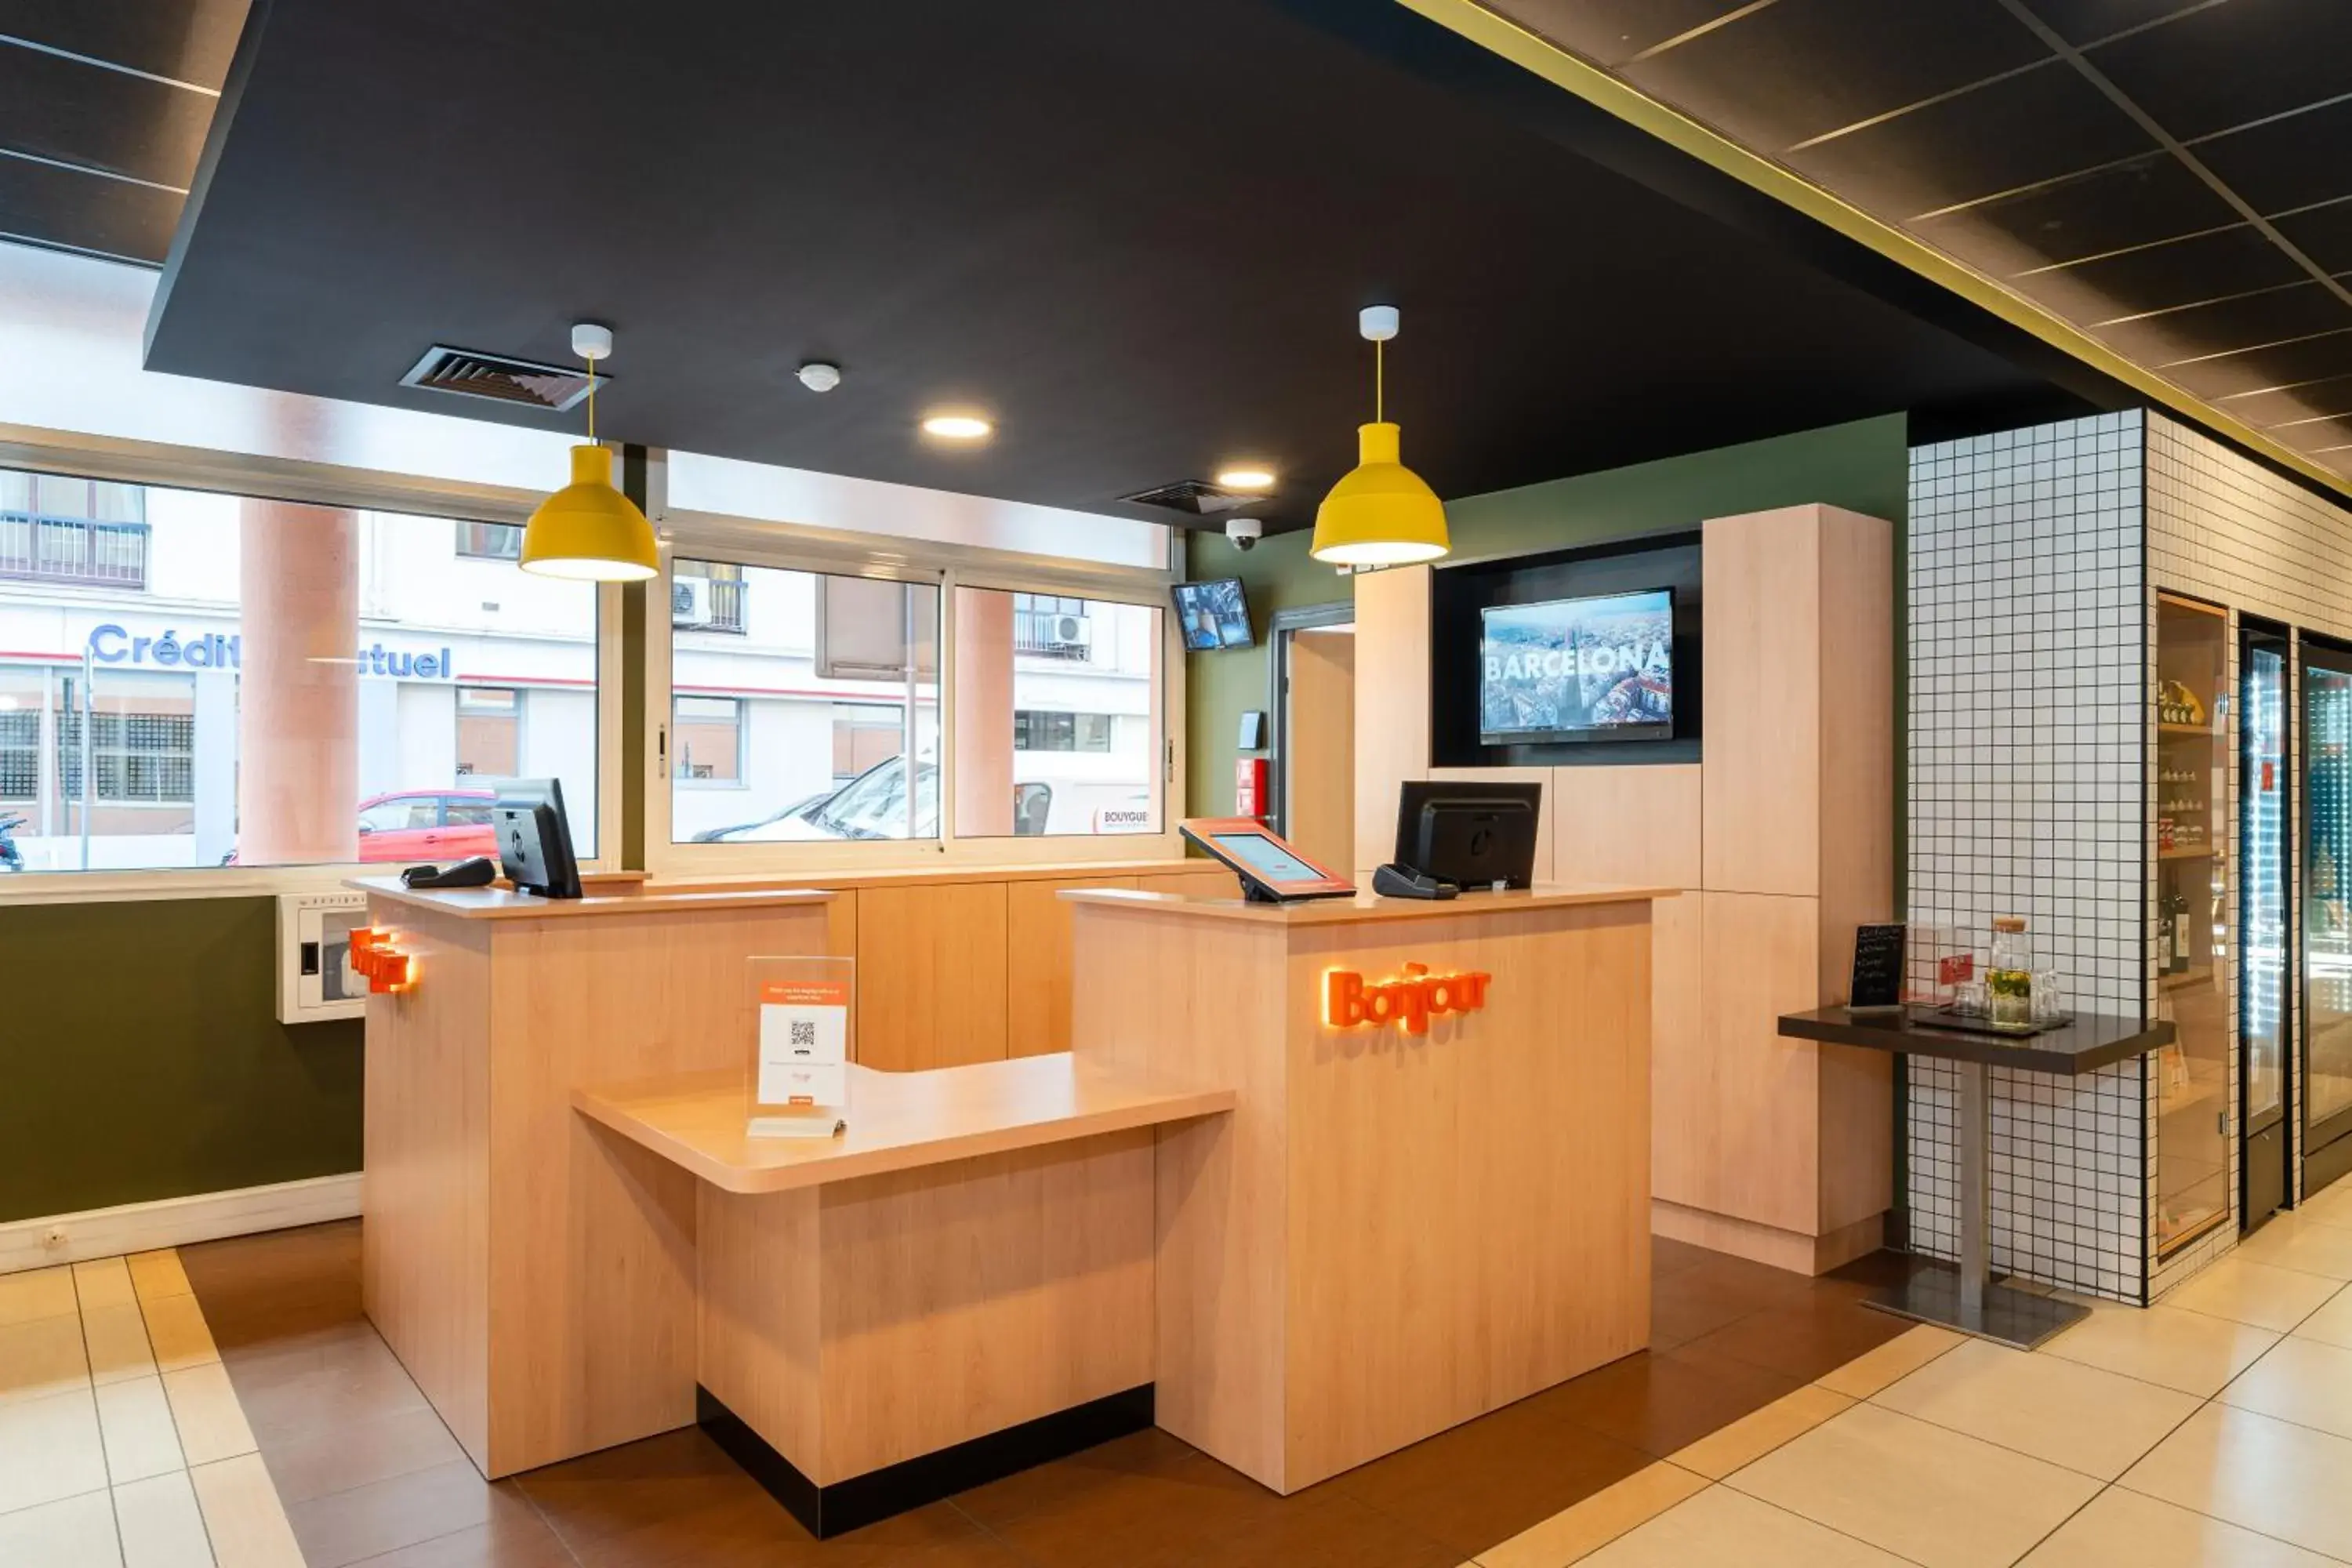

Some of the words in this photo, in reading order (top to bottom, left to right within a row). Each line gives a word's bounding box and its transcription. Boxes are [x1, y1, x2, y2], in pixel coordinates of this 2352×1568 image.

[89, 623, 241, 668] Crédit
[358, 643, 450, 678] tuel
[1485, 641, 1668, 681] BARCELONA
[1327, 961, 1492, 1034] Bonjour
